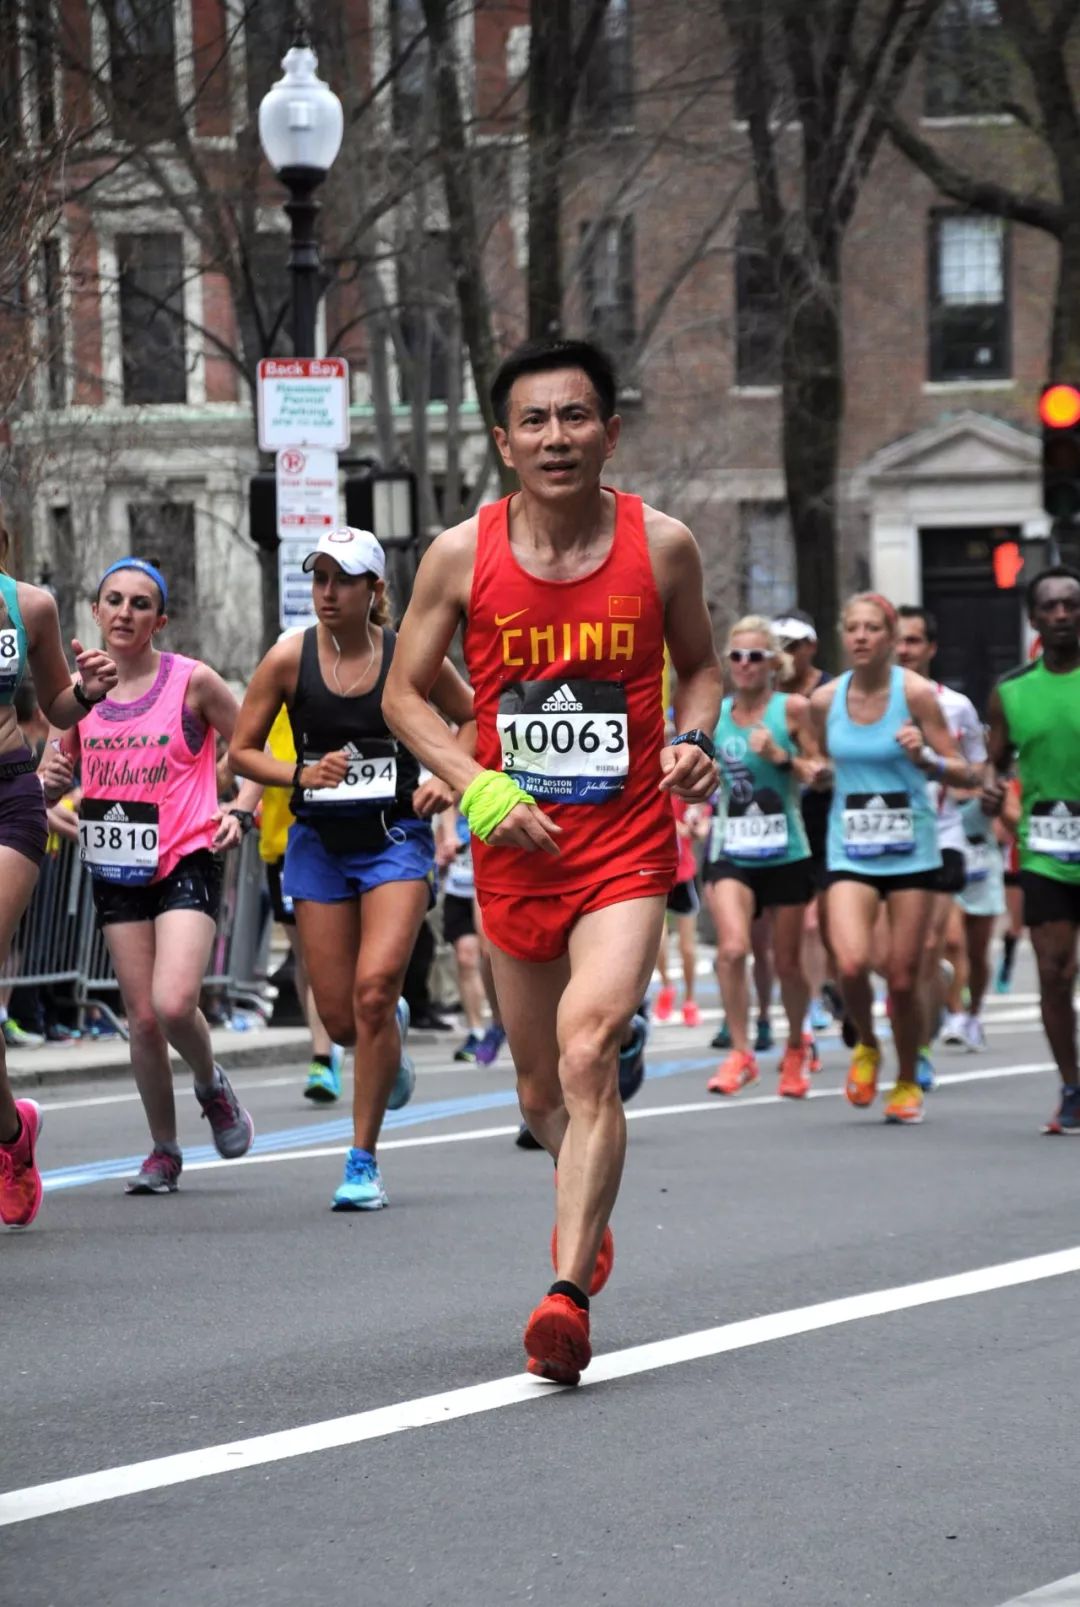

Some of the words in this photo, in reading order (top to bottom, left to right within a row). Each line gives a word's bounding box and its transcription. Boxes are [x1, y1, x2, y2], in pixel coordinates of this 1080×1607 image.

[265, 361, 304, 375] Back
[309, 361, 339, 377] Bay
[502, 622, 635, 666] CHINA
[541, 700, 583, 712] adidas
[504, 720, 624, 753] 10063
[505, 752, 514, 768] 3
[86, 754, 168, 793] Pittsburgh
[344, 761, 393, 786] 694
[526, 776, 540, 785] 2017
[543, 778, 572, 788] BOSTON
[525, 784, 572, 795] MARATHON
[80, 825, 158, 851] 13810
